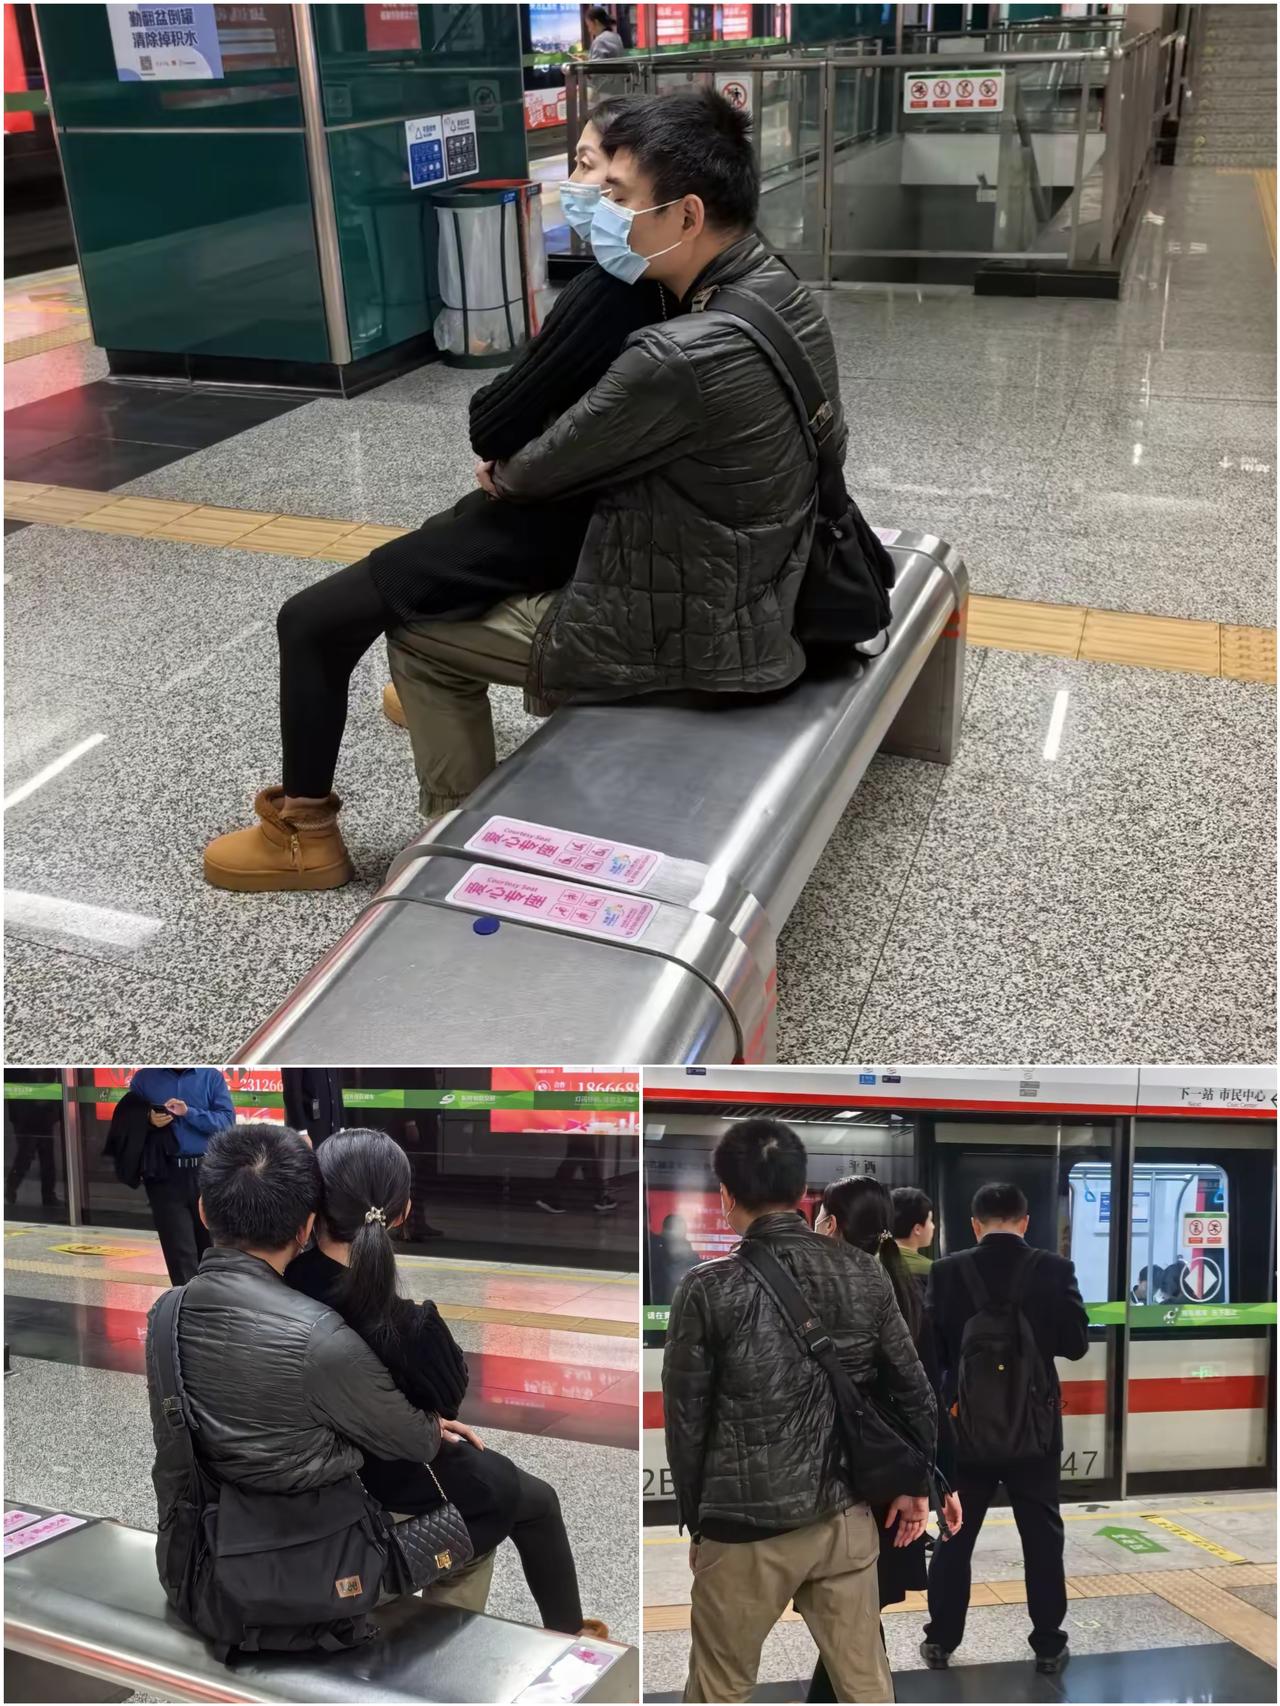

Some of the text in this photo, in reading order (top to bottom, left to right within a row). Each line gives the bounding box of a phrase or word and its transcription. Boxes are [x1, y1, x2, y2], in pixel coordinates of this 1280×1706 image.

[128, 8, 195, 27] 勤翻盆倒罐
[132, 30, 198, 48] 清除掉积水
[481, 831, 560, 857] 爱心专座
[464, 881, 548, 909] 爱心专座
[1178, 1086, 1266, 1102] 下一站 市民中心
[1060, 1451, 1098, 1476] 47
